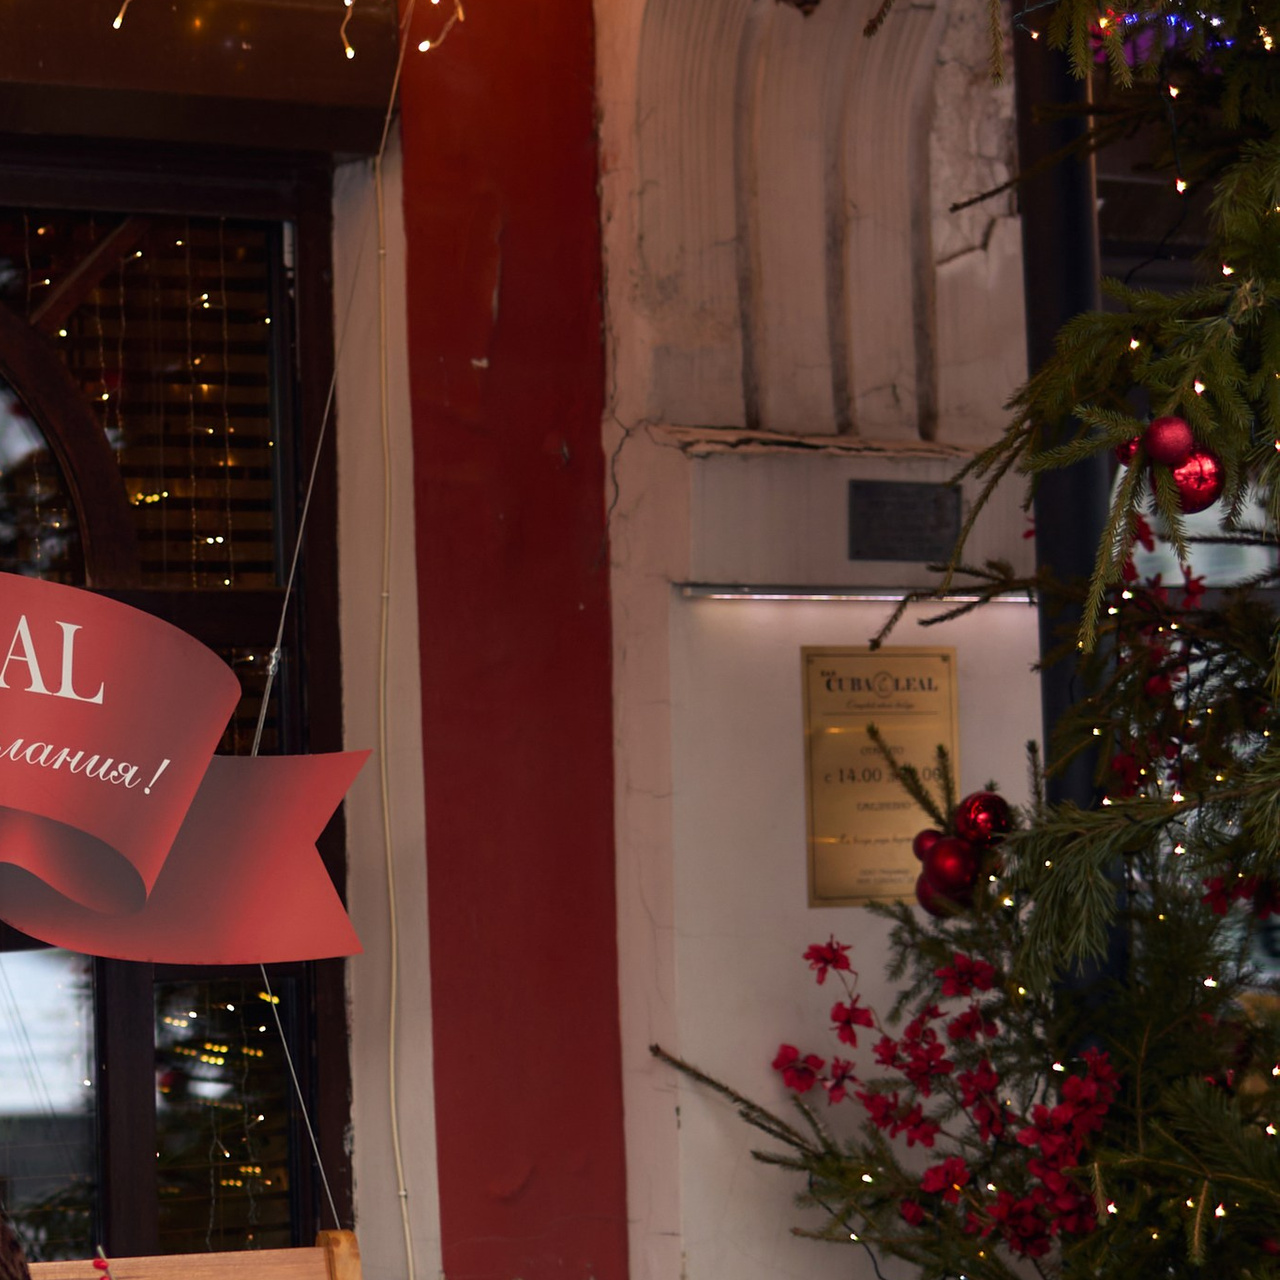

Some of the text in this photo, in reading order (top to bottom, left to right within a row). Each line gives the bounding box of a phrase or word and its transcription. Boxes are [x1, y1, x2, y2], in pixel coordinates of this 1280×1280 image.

[825, 676, 939, 693] CUBA LEAL
[838, 767, 882, 783] 14.00
